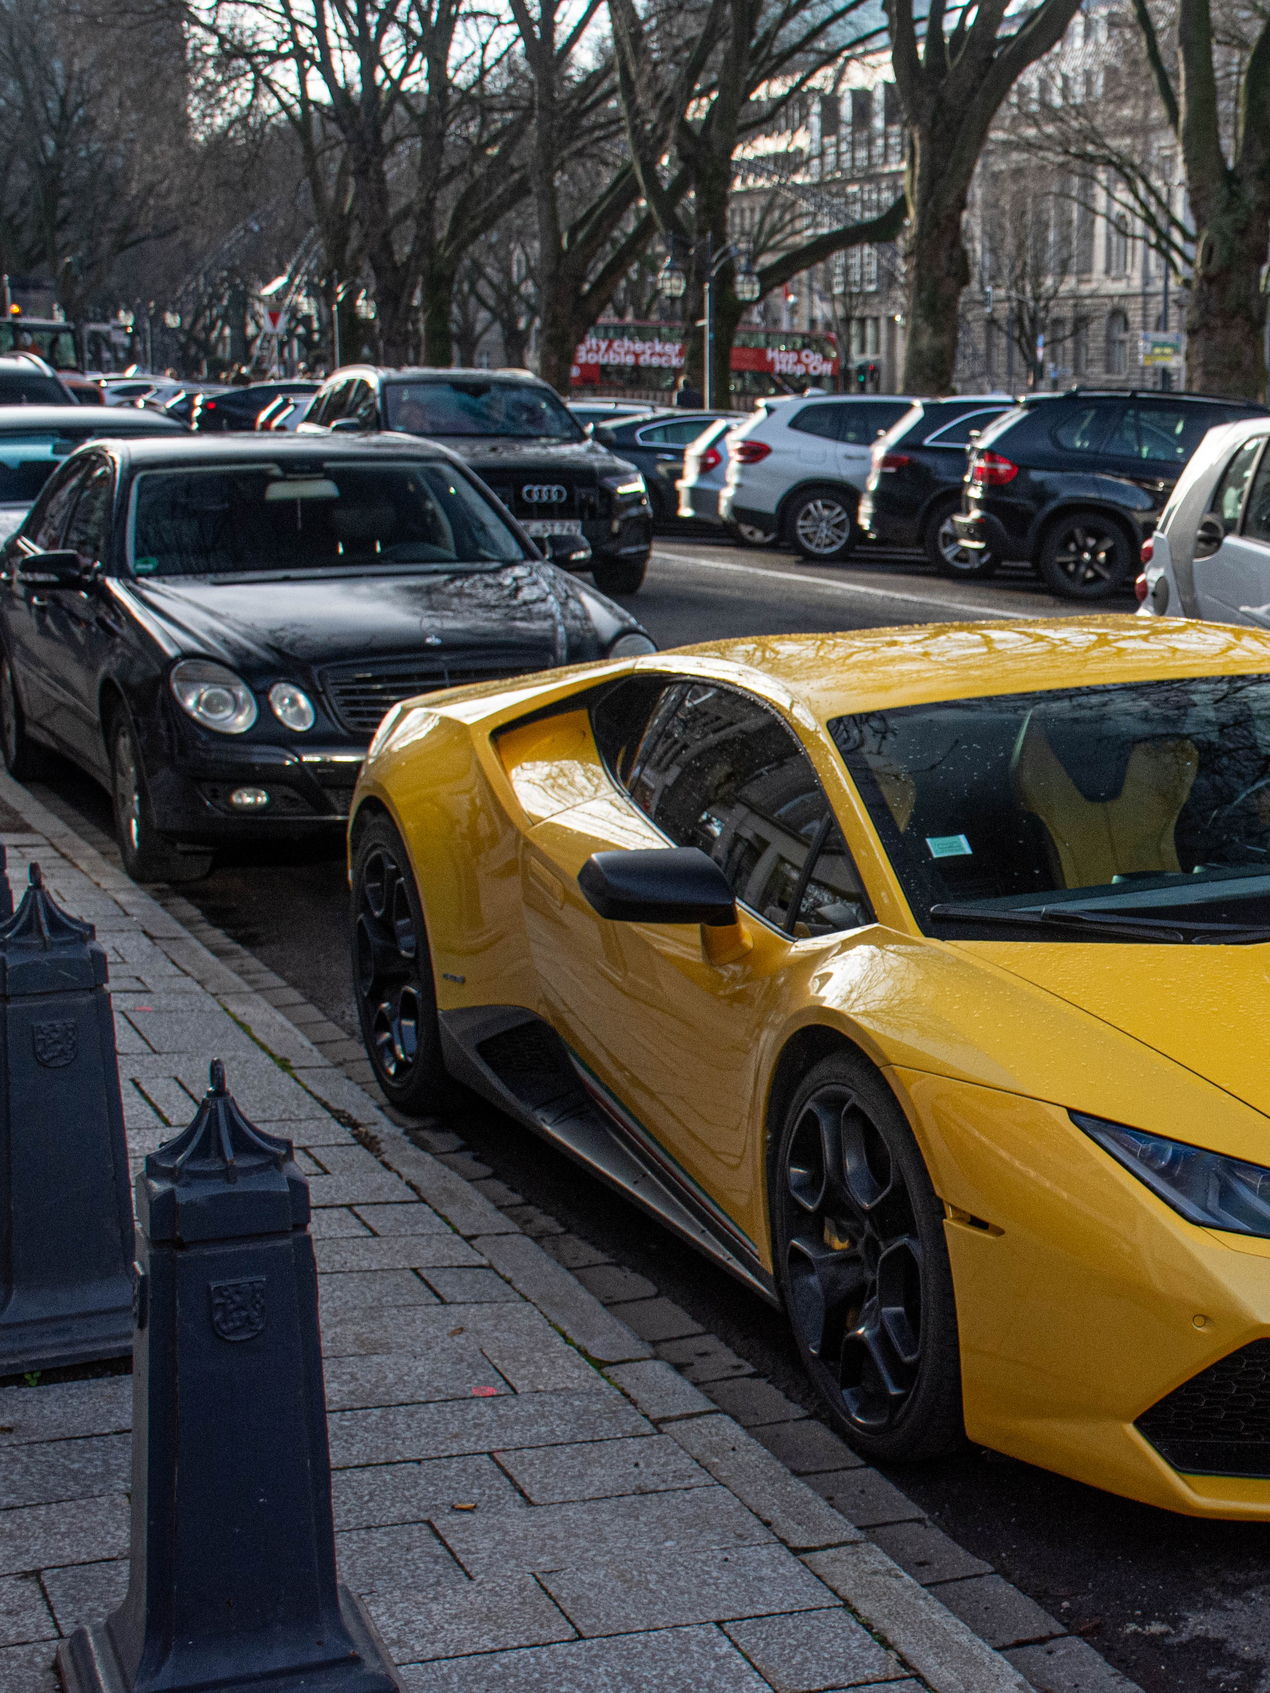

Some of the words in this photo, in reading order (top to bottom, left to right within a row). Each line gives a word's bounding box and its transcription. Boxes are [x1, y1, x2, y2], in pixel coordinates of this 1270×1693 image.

[612, 335, 682, 354] checker
[766, 347, 798, 368] Hop
[800, 348, 823, 364] On
[774, 357, 806, 378] Hop
[808, 359, 833, 377] Off
